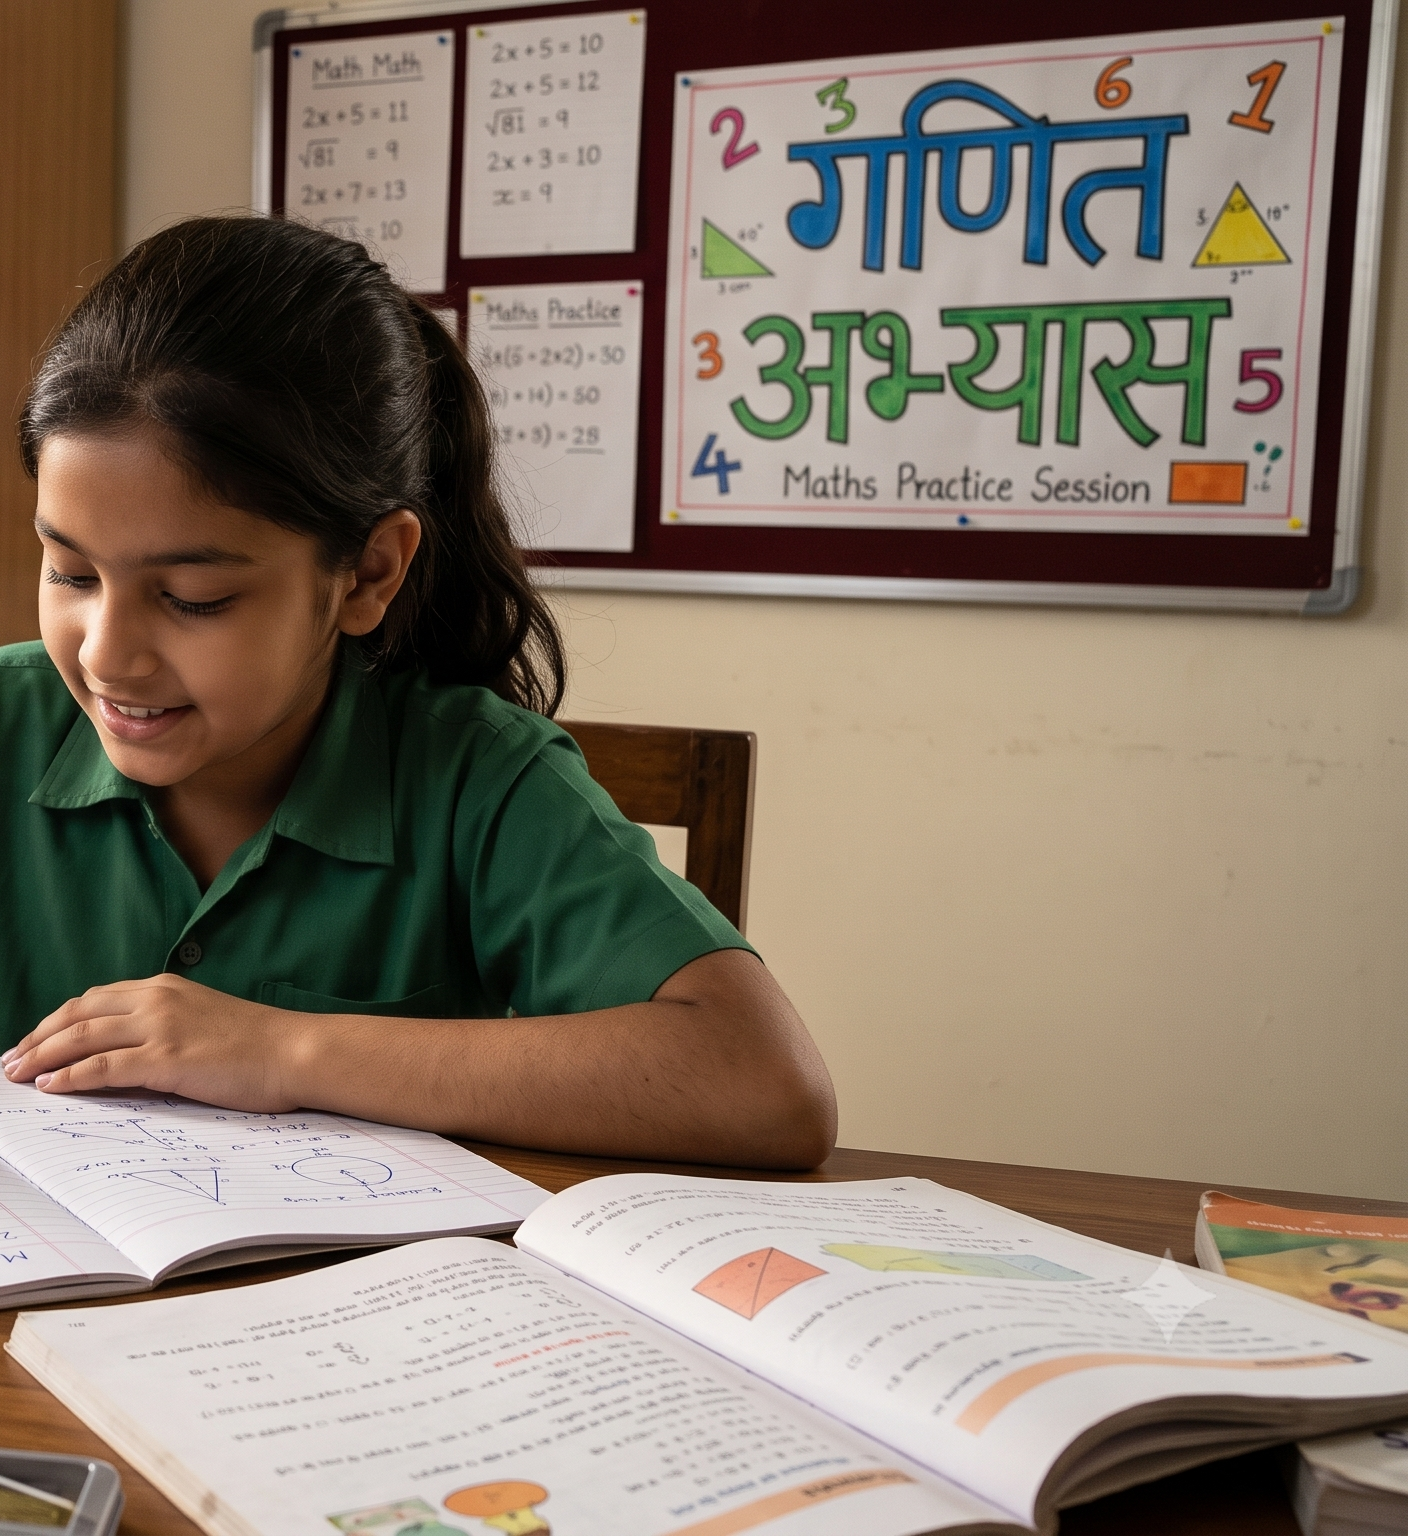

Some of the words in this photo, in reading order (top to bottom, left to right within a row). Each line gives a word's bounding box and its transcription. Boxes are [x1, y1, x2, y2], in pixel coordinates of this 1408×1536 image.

[539, 38, 554, 59] 5
[578, 33, 604, 55] 10
[312, 58, 363, 82] Math
[373, 53, 422, 76] Math
[540, 74, 554, 96] 5
[578, 71, 601, 92] 12
[1094, 57, 1133, 109] 6
[1227, 60, 1288, 134] 1
[349, 102, 364, 125] 5
[388, 101, 408, 122] 11
[556, 109, 569, 130] 9
[815, 77, 856, 134] 3
[387, 140, 399, 162] 9
[710, 107, 759, 170] 2
[539, 148, 553, 169] 3
[576, 145, 602, 166] 10
[348, 182, 362, 202] 7
[384, 180, 407, 200] 13
[787, 79, 1190, 274] गणित
[539, 183, 552, 203] 9
[381, 219, 403, 240] 10
[487, 303, 538, 321] Maths
[548, 297, 621, 322] Practice
[692, 331, 723, 381] 3
[729, 297, 1232, 449] अभ्यास
[1233, 348, 1285, 414] 5
[691, 434, 742, 496] 4
[783, 466, 878, 500] Maths
[898, 463, 1012, 502] Practice
[1031, 465, 1152, 503] Session
